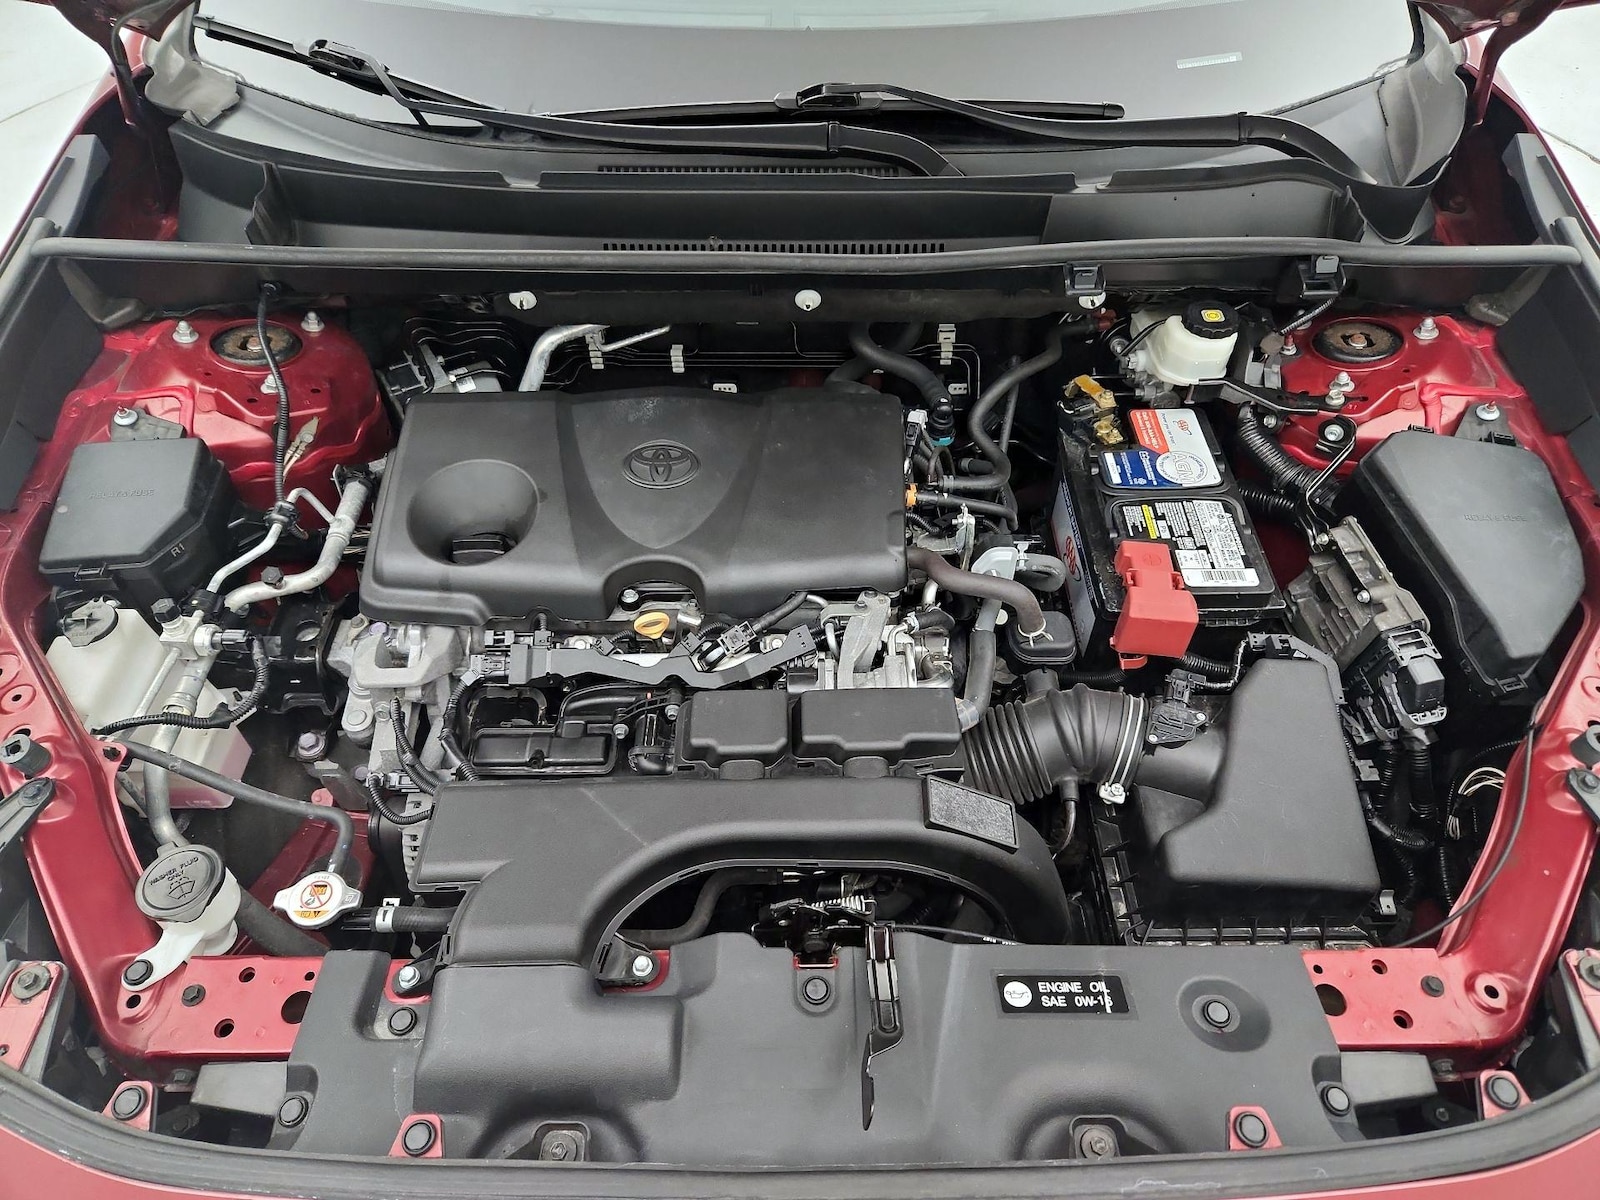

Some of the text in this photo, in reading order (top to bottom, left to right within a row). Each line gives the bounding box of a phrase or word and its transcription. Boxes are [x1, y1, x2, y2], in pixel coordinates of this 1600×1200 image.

[1173, 454, 1196, 484] AGM
[170, 543, 185, 557] R1
[149, 856, 199, 885] WASHER FLUID
[168, 869, 184, 881] ONLY
[1037, 981, 1110, 993] ENGINE OIL
[1041, 996, 1067, 1007] SAE
